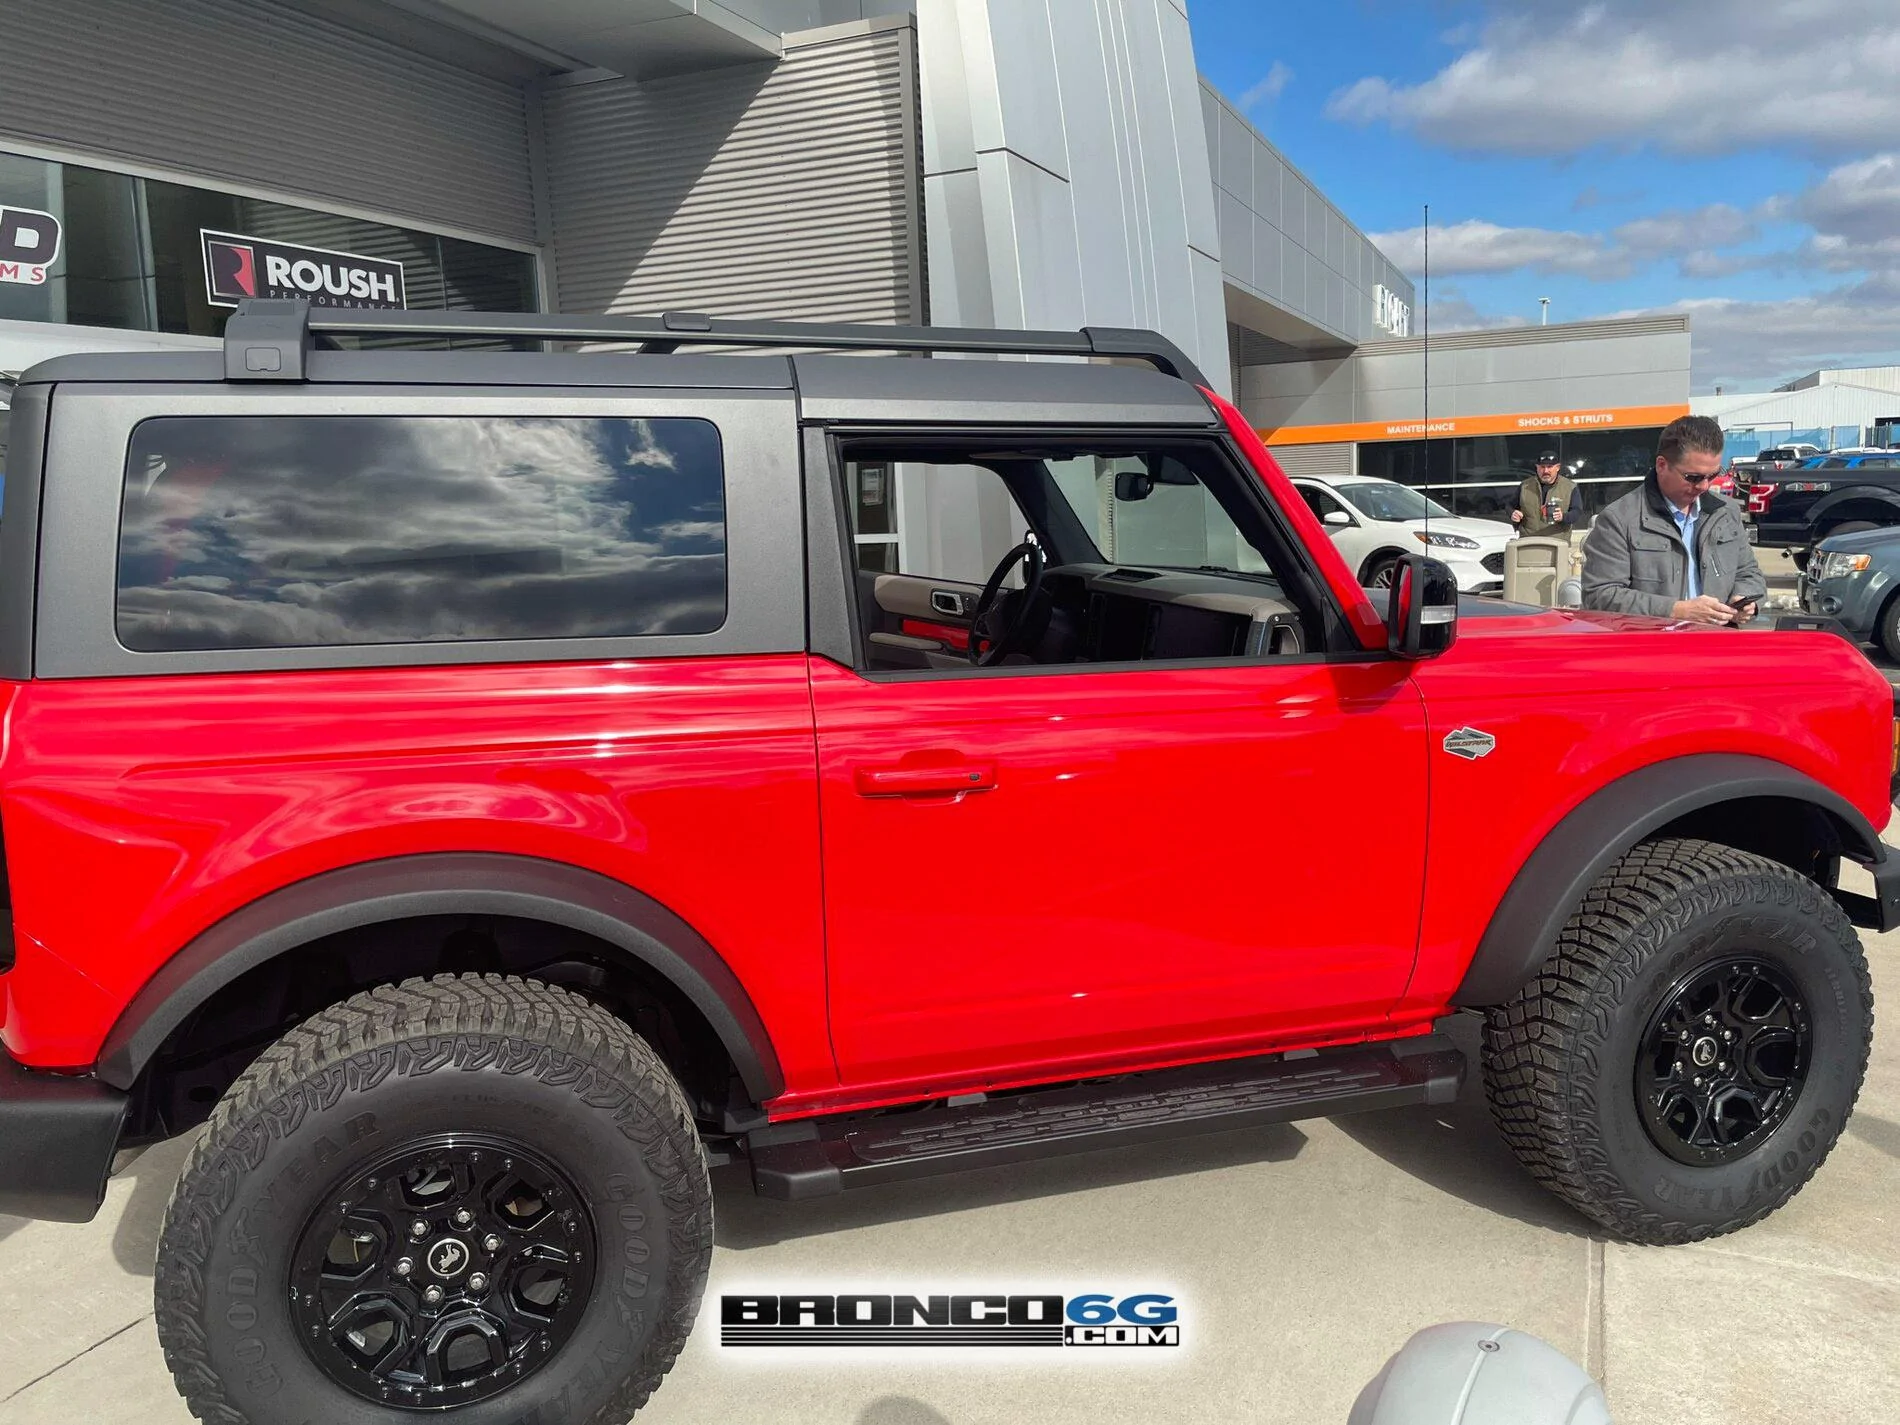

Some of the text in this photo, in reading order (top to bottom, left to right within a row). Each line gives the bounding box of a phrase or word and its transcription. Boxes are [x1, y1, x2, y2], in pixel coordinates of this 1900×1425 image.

[265, 255, 395, 302] ROUSH
[1518, 414, 1613, 427] SHOCKS & STRUTS
[1386, 422, 1456, 434] MAINTENANCE
